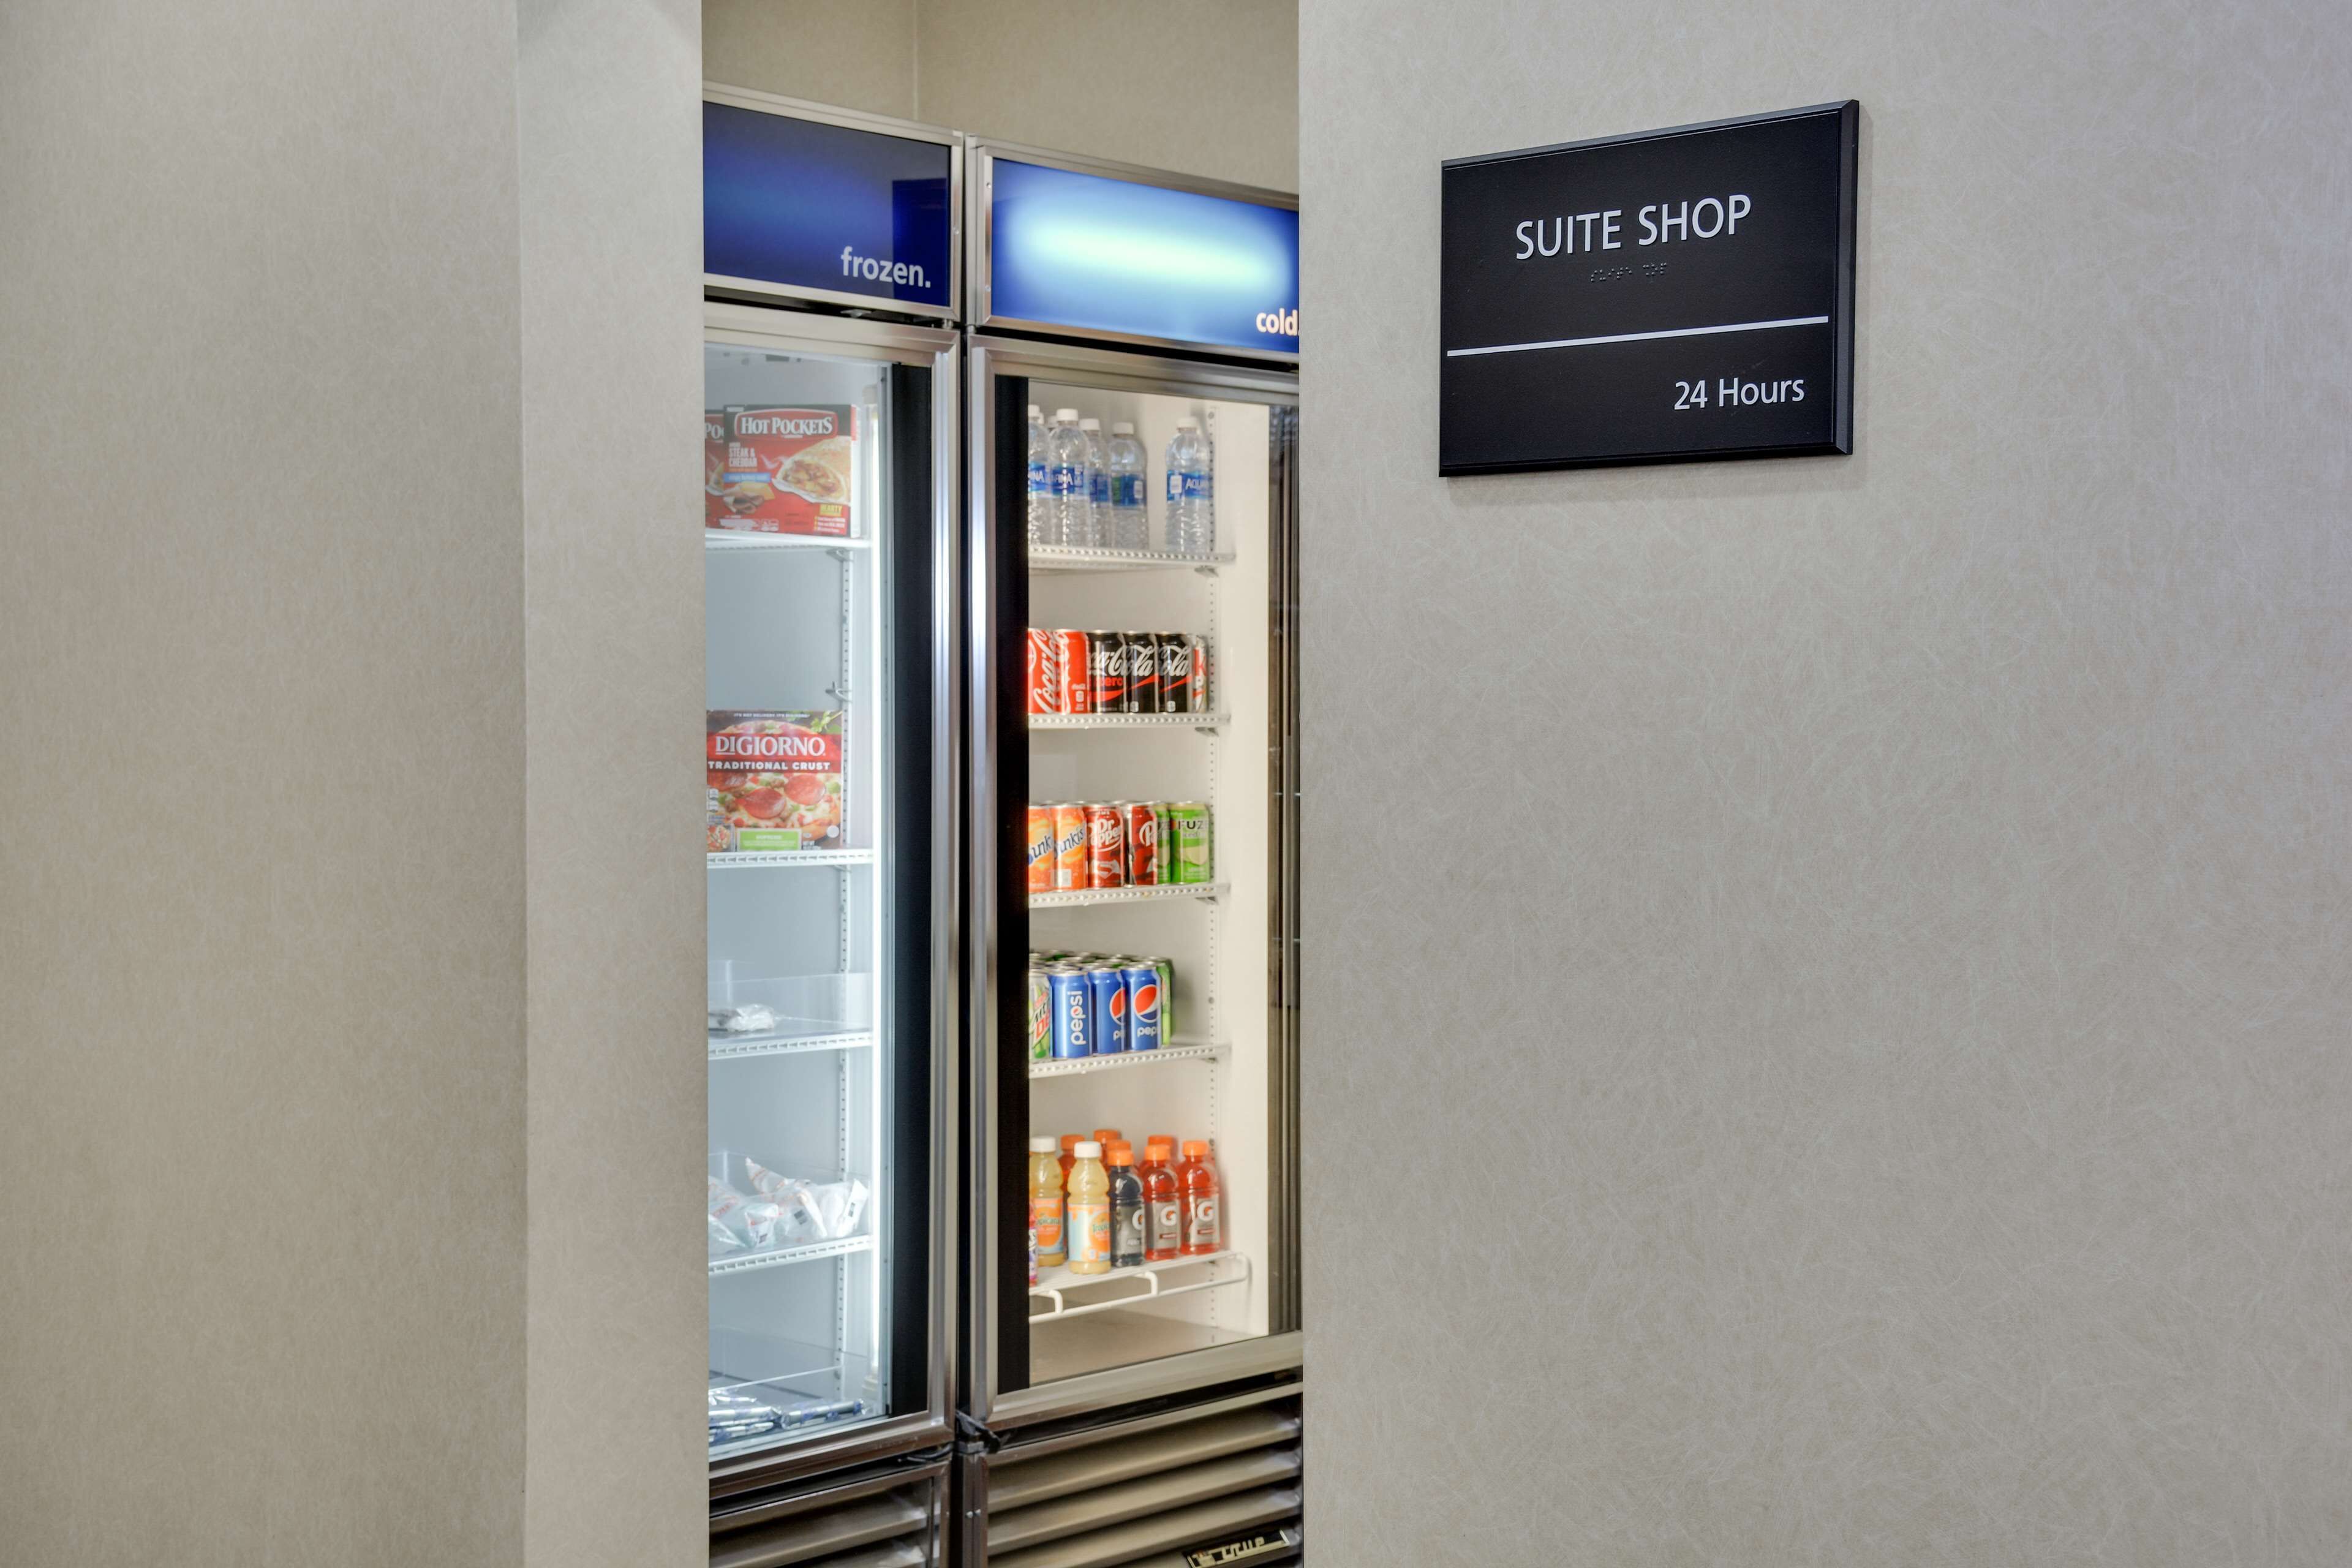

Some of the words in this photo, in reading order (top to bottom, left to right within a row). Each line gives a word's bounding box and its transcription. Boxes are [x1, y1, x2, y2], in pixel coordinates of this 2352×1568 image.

[1517, 210, 1621, 259] SUITE
[1639, 195, 1751, 245] SHOP
[841, 246, 930, 287] frozen.
[1675, 380, 1707, 410] 24
[1719, 378, 1804, 406] Hours
[741, 417, 770, 435] HOT
[772, 417, 833, 435] POCKETS
[715, 736, 826, 756] DIGIORNO
[708, 761, 788, 771] TRADITIONAL
[792, 762, 831, 771] CRUST
[1067, 990, 1087, 1046] pepsi
